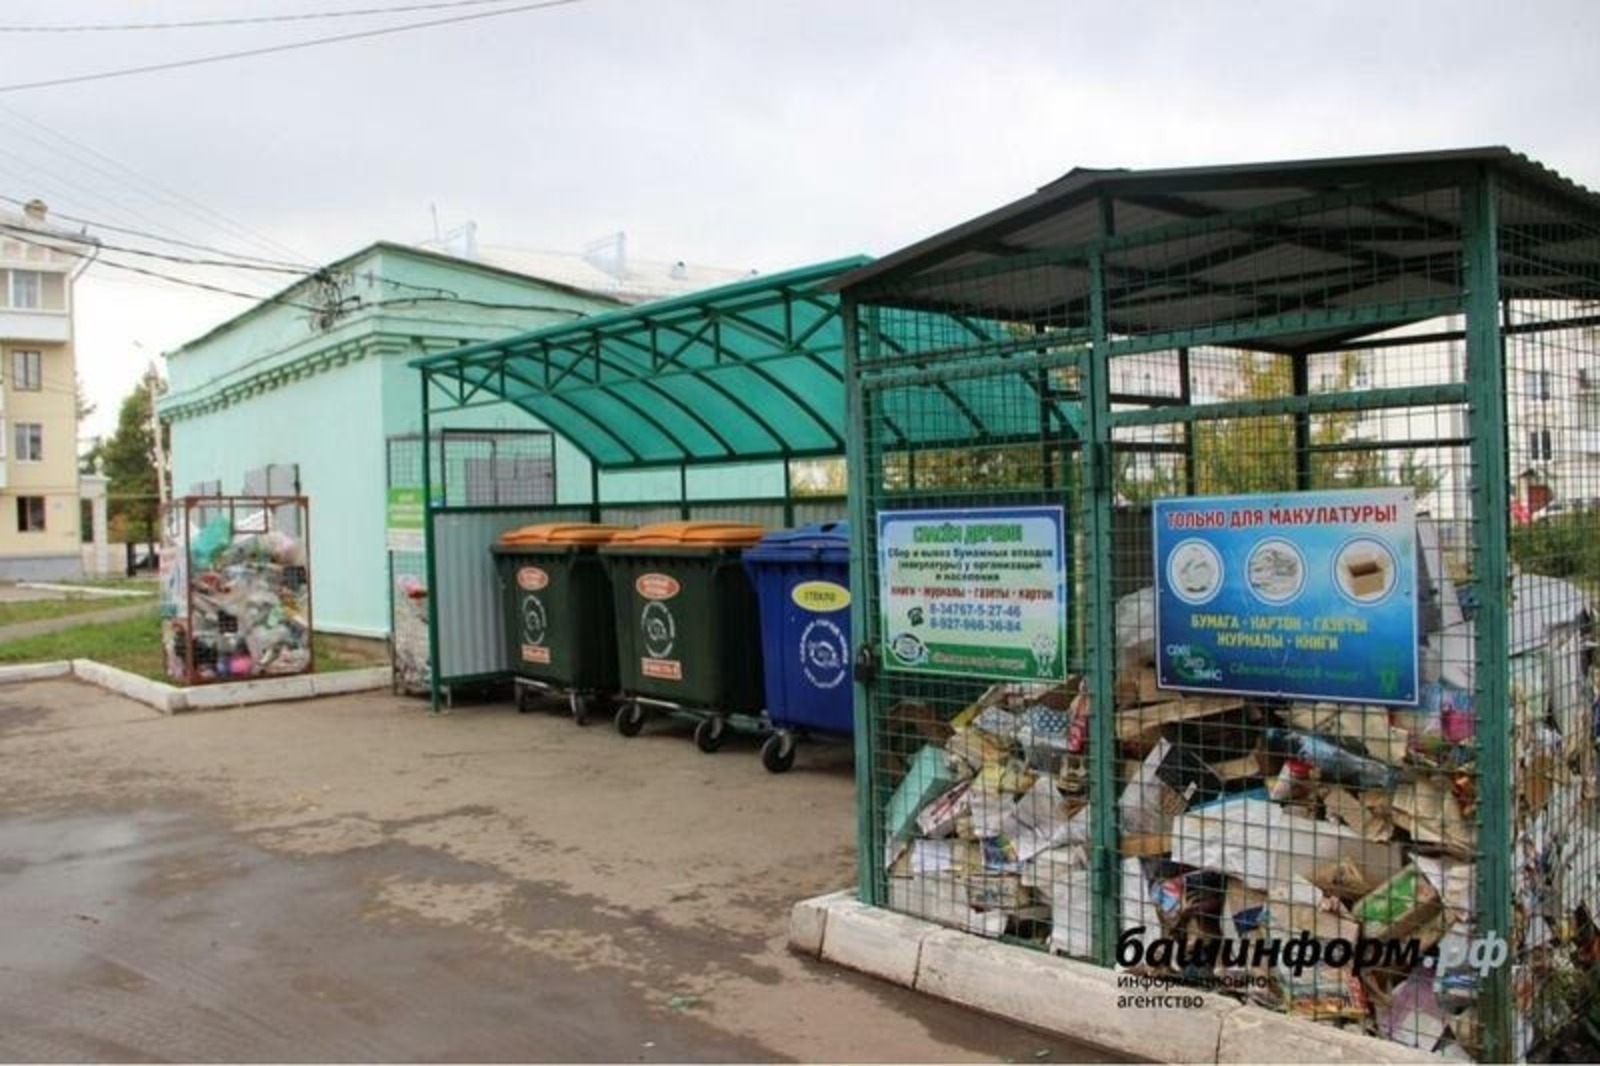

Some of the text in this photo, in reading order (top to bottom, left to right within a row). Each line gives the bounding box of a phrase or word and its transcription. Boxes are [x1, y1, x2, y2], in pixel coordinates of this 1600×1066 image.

[1167, 504, 1398, 529] ТОЛЬКО ДЛЯ МАКУЛАТУРЫ!
[1191, 614, 1239, 629] БУМАГА
[1251, 614, 1300, 631] КАРТОН
[1217, 632, 1339, 650] ЖУРНАЛЫ КНИГИ
